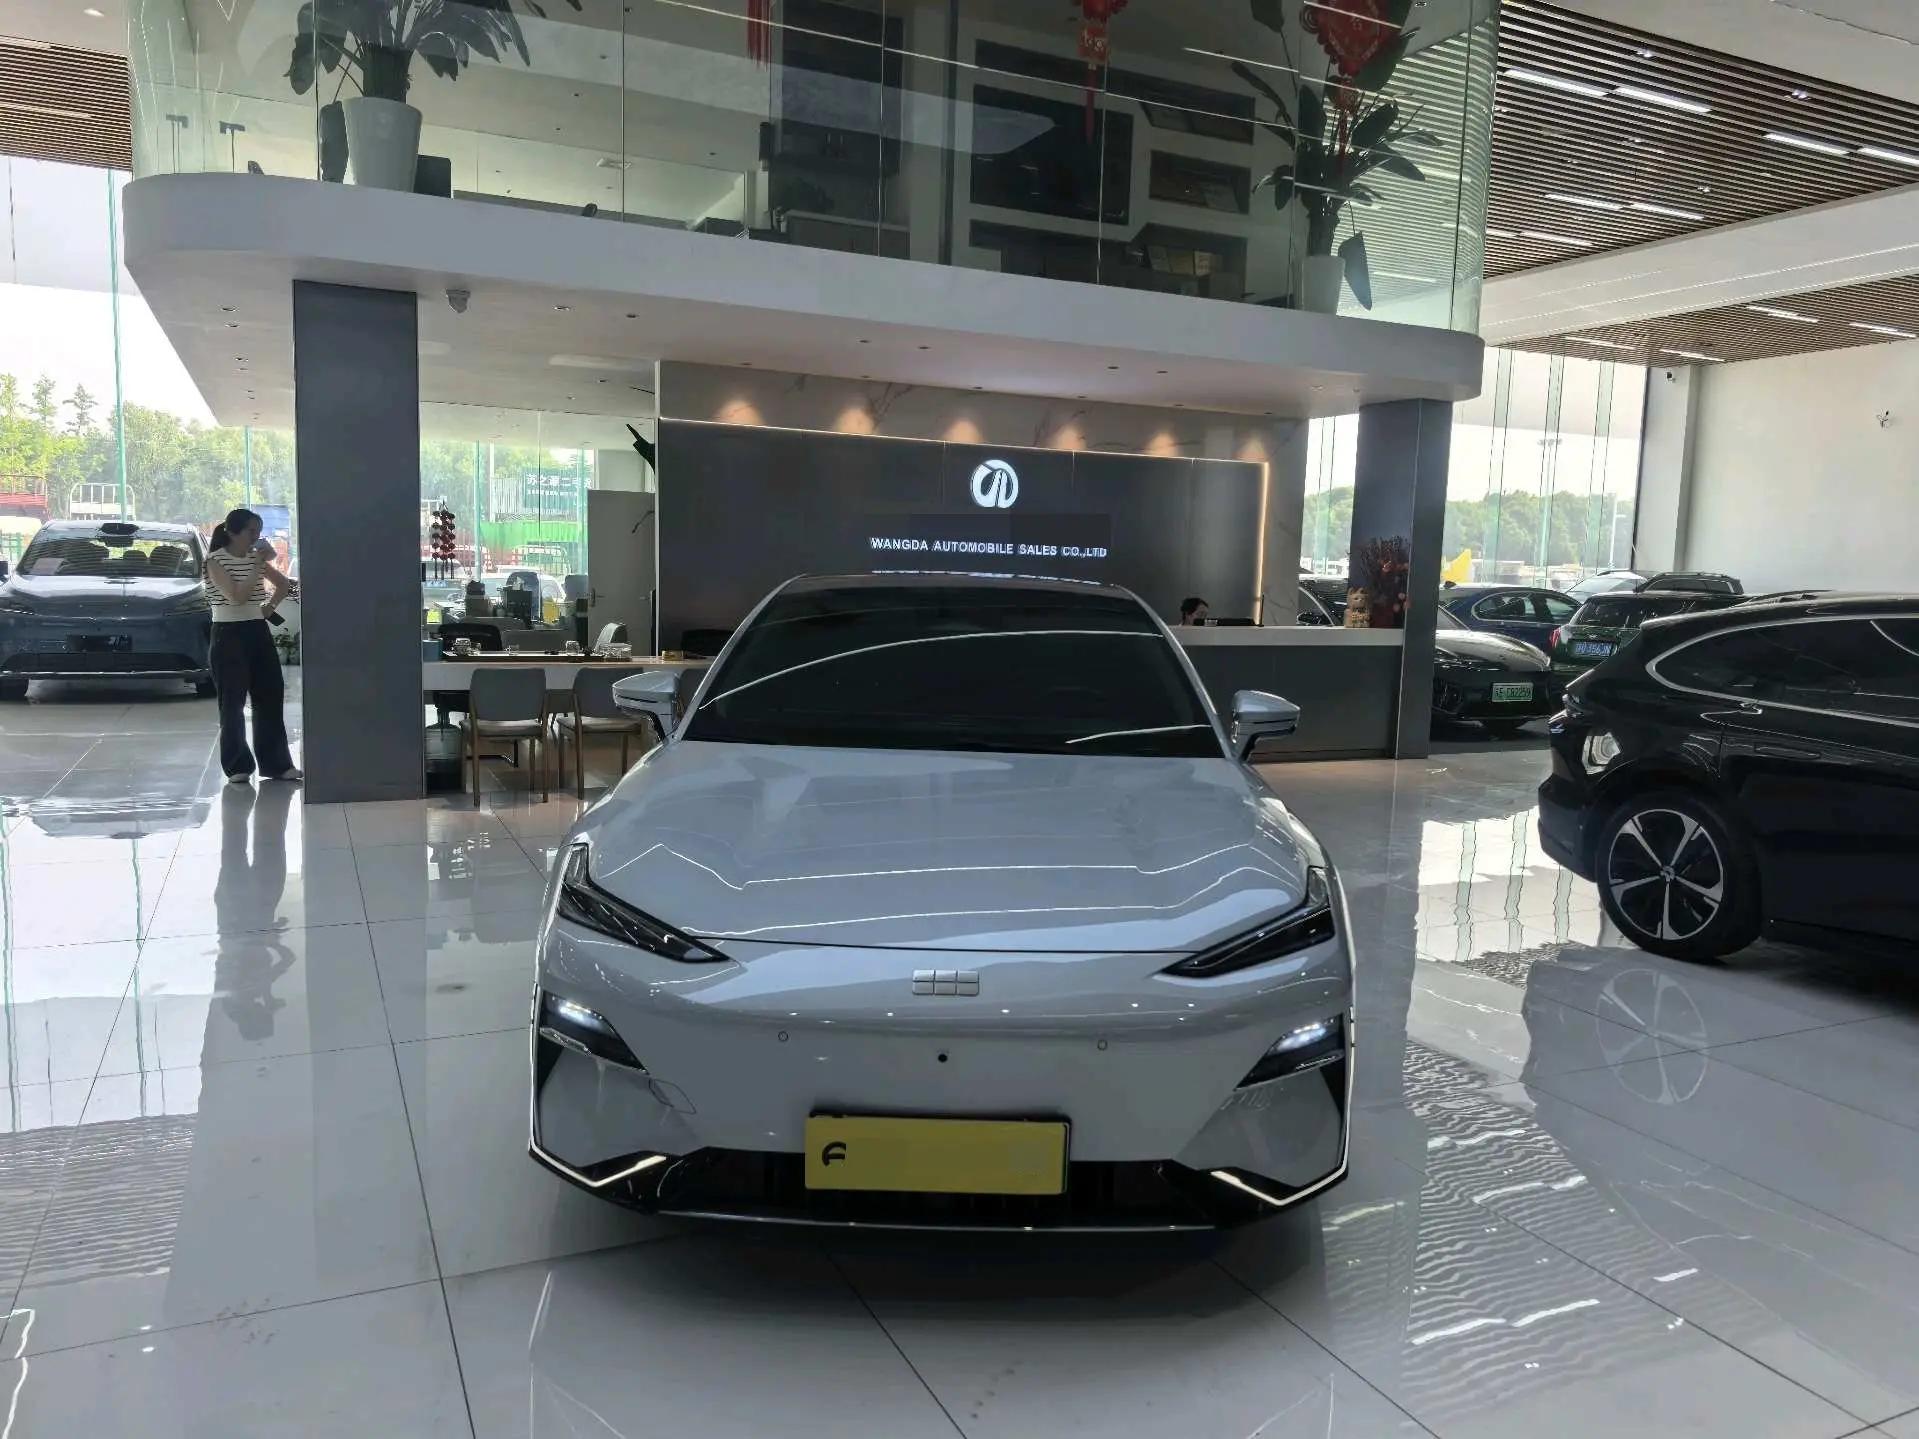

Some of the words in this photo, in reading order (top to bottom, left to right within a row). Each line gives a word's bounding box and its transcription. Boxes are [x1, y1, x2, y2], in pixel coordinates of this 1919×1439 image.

[871, 538, 928, 551] WANGDA
[933, 541, 1014, 554] AUTOMOBILE
[1018, 544, 1057, 556] SALES
